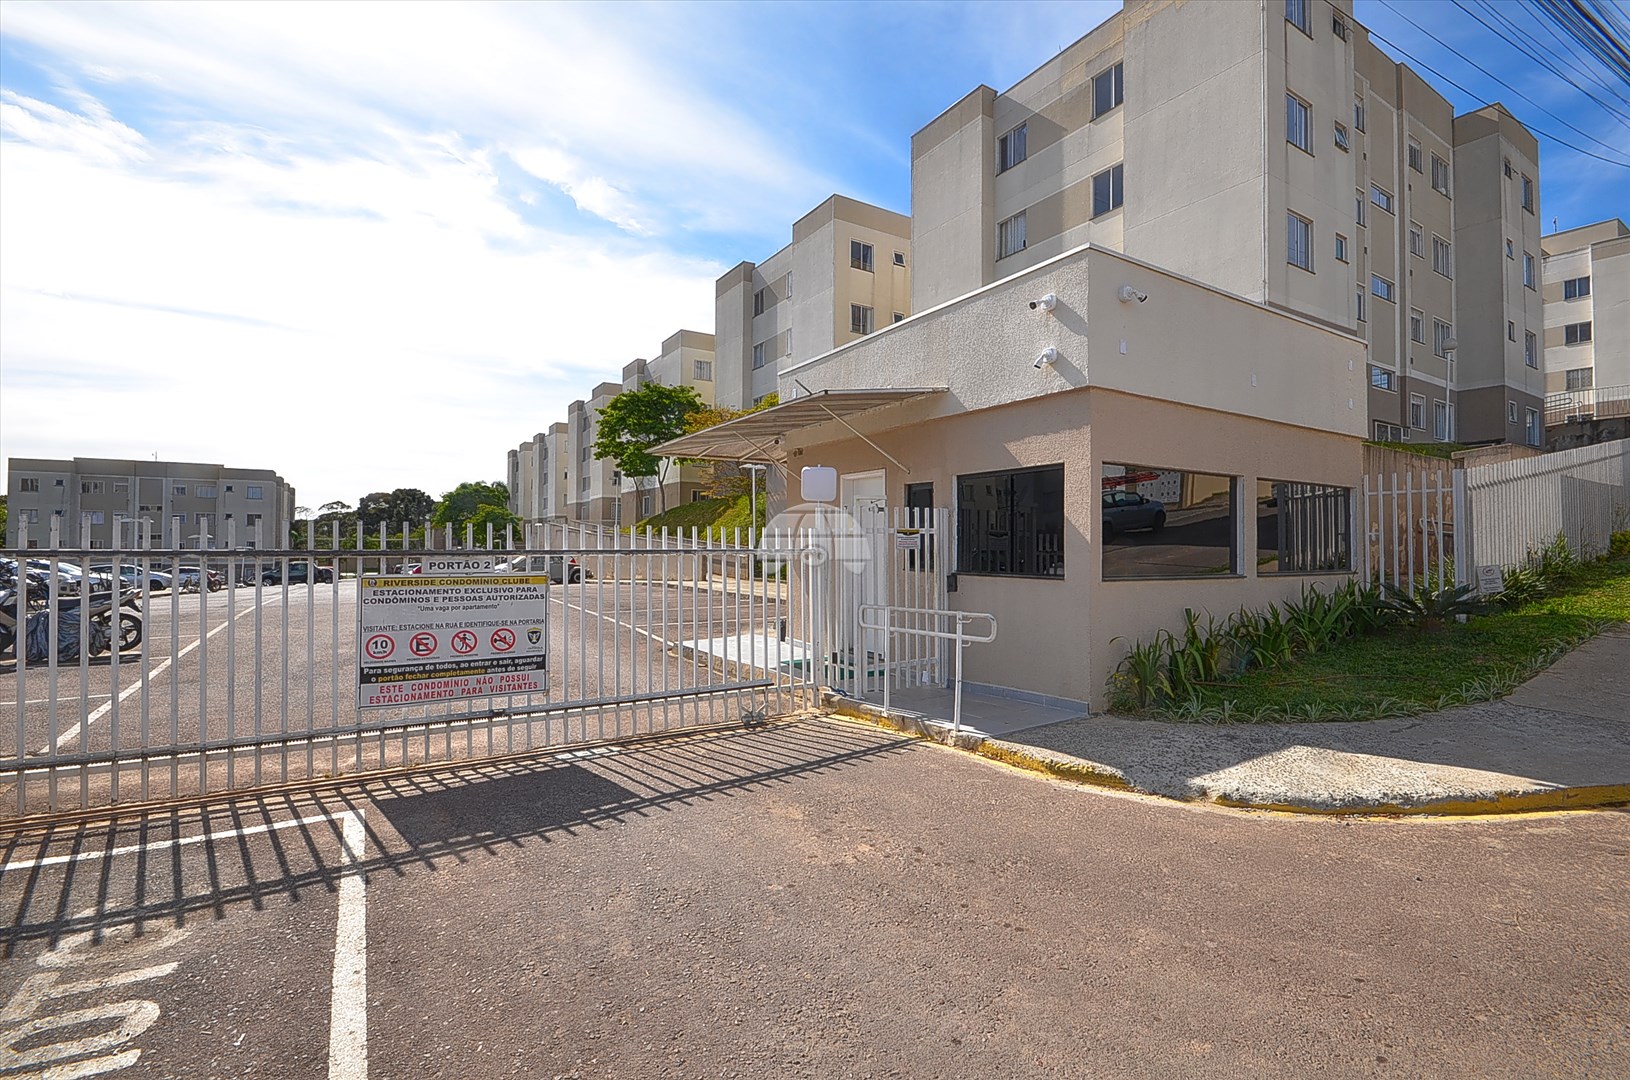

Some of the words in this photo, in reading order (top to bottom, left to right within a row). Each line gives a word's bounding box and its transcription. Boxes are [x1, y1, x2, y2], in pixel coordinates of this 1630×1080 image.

[429, 560, 480, 570] PORTÃO
[484, 561, 491, 569] 2
[439, 577, 499, 585] CONDOMÍNIO
[372, 588, 461, 596] ESTACIONAMENTO
[363, 596, 431, 604] CONDÔMINOS
[399, 623, 434, 631] ESTACIONE
[372, 640, 388, 650] 10
[384, 665, 424, 674] segurança
[514, 656, 544, 664] aguardar
[378, 674, 404, 682] portão
[405, 672, 429, 680] fechar
[430, 668, 486, 678] completamente
[516, 664, 537, 672] seguir
[380, 684, 404, 694] ESTE
[411, 679, 469, 692] CONDOMÍNIO
[476, 676, 494, 686] NÃO
[500, 674, 530, 683] POSSUI
[370, 690, 454, 704] ESTACIONAMENTO
[462, 687, 483, 696] PARA
[490, 682, 538, 692] VISITANTES
